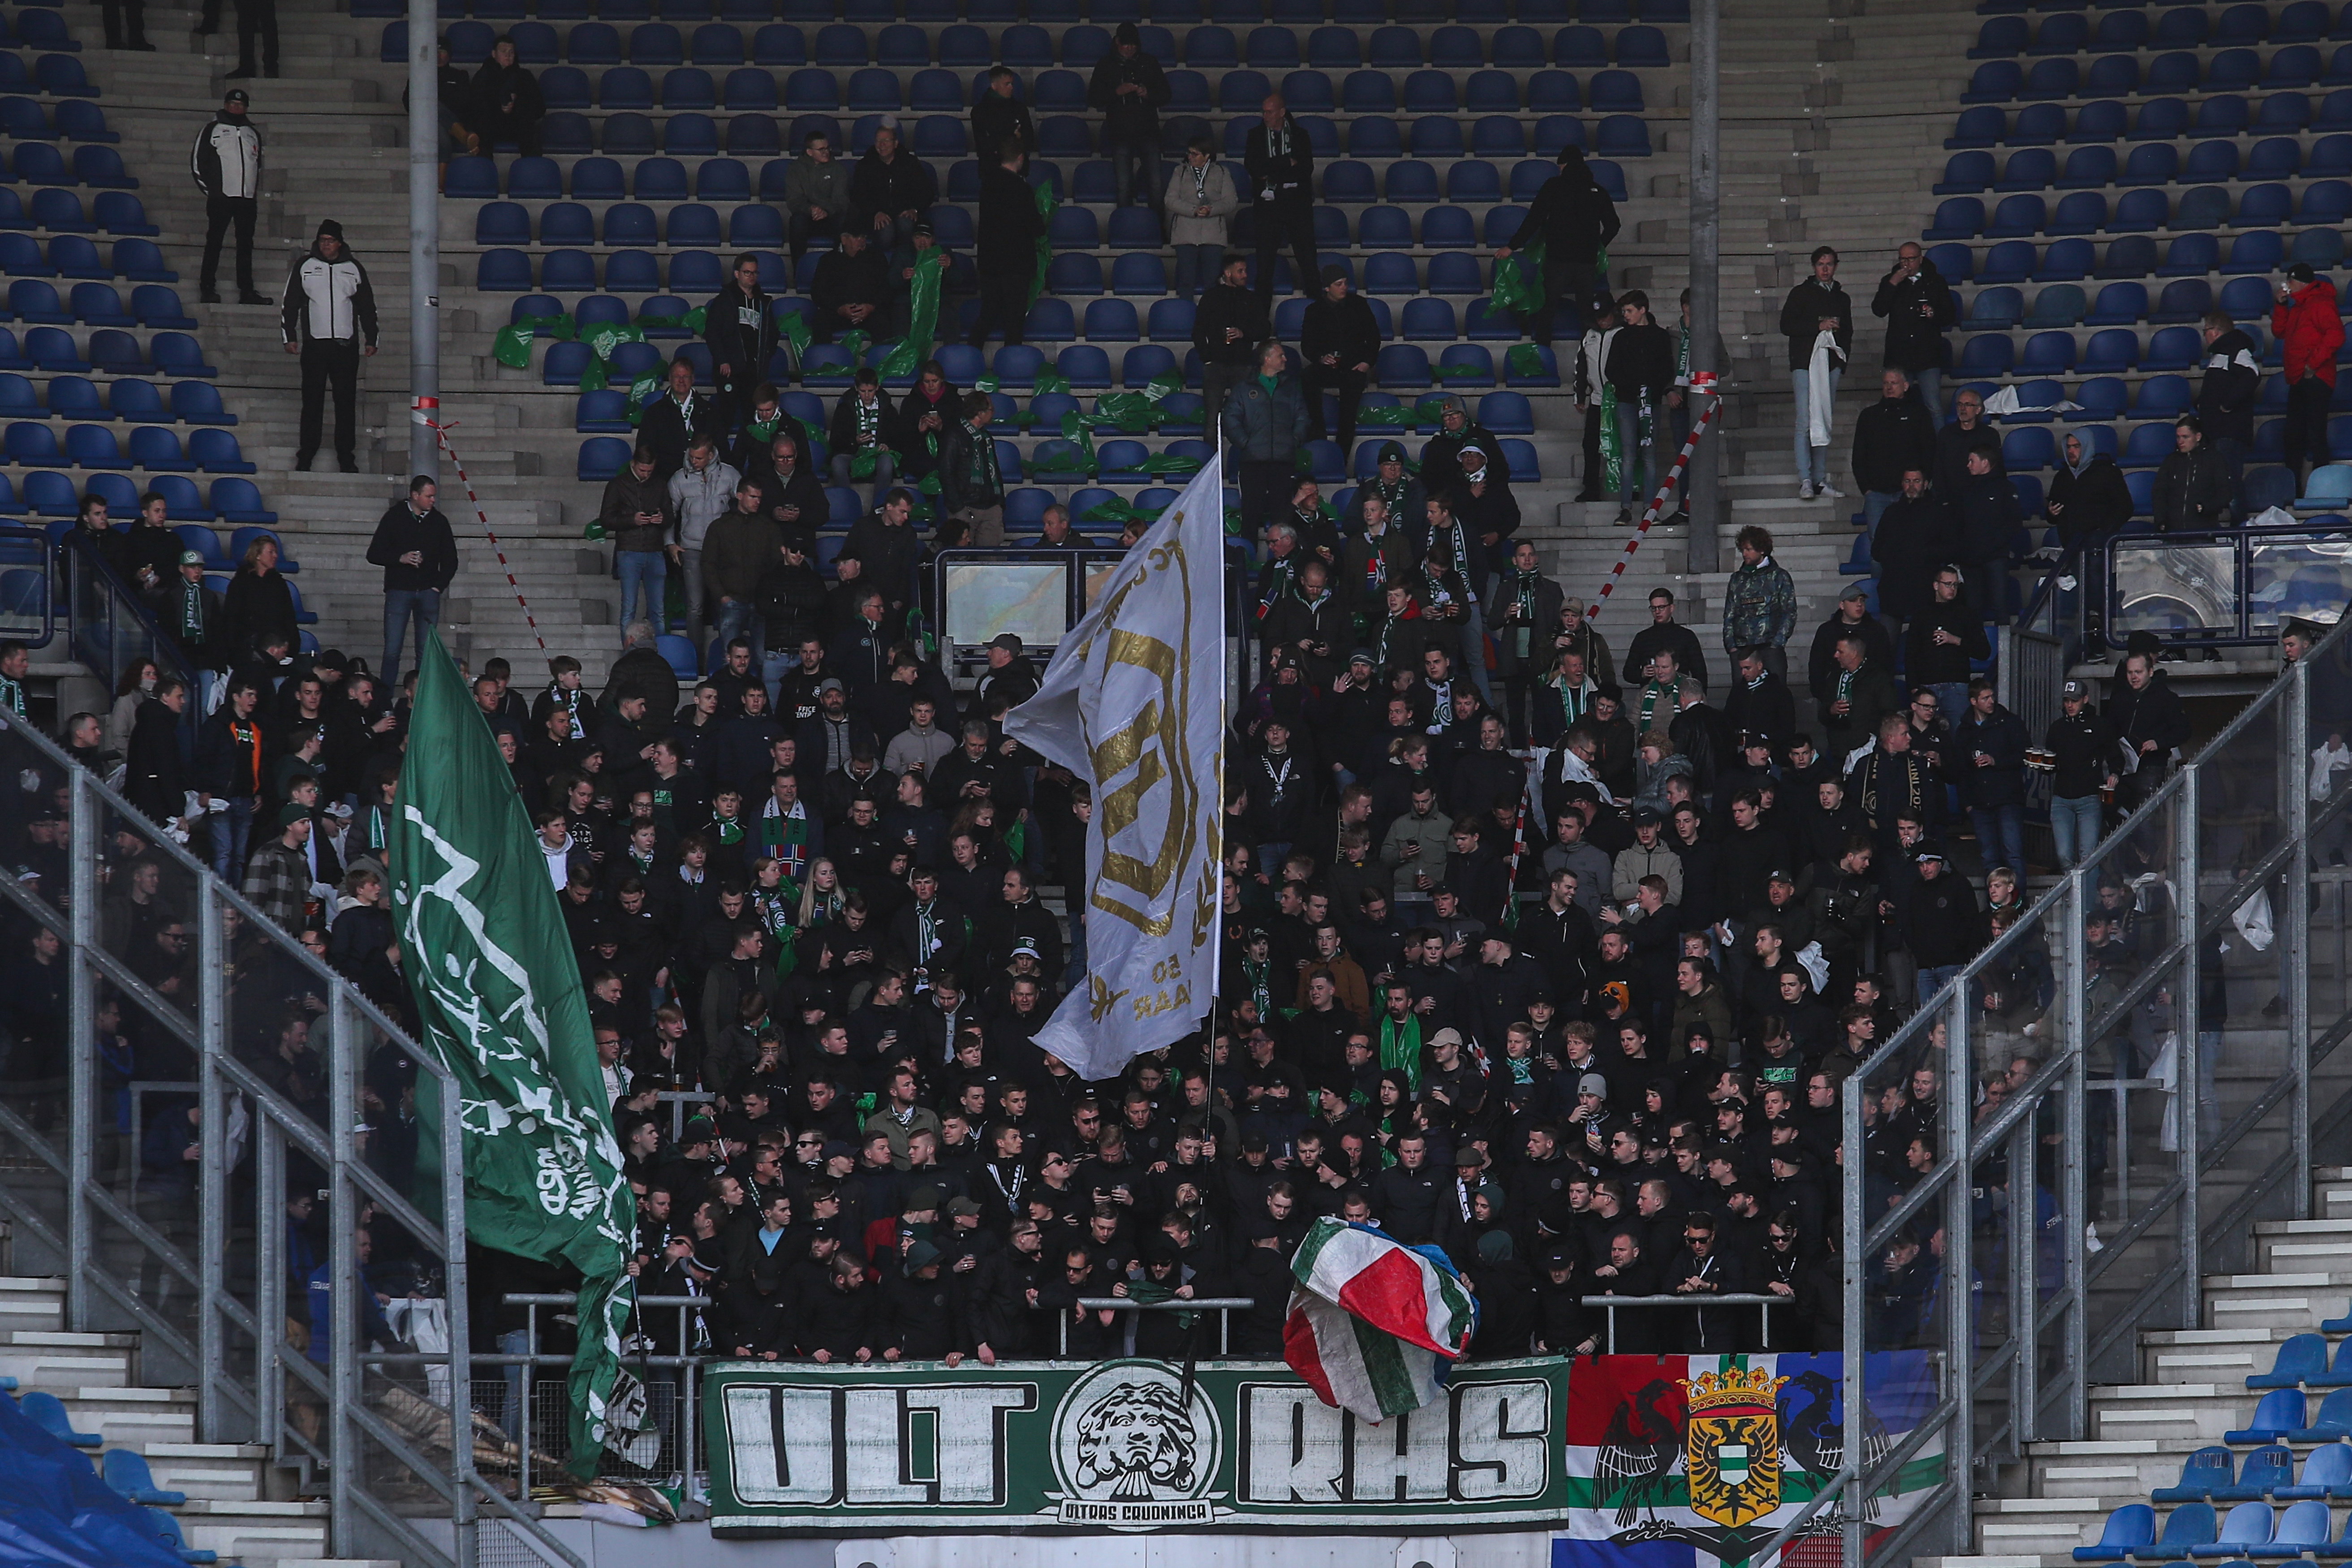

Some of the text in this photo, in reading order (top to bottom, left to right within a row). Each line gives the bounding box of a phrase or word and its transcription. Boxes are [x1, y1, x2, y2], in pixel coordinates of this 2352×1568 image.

[1679, 351, 1689, 371] TOUR
[796, 705, 817, 713] FFICE
[1066, 1503, 1117, 1520] ULTRAS
